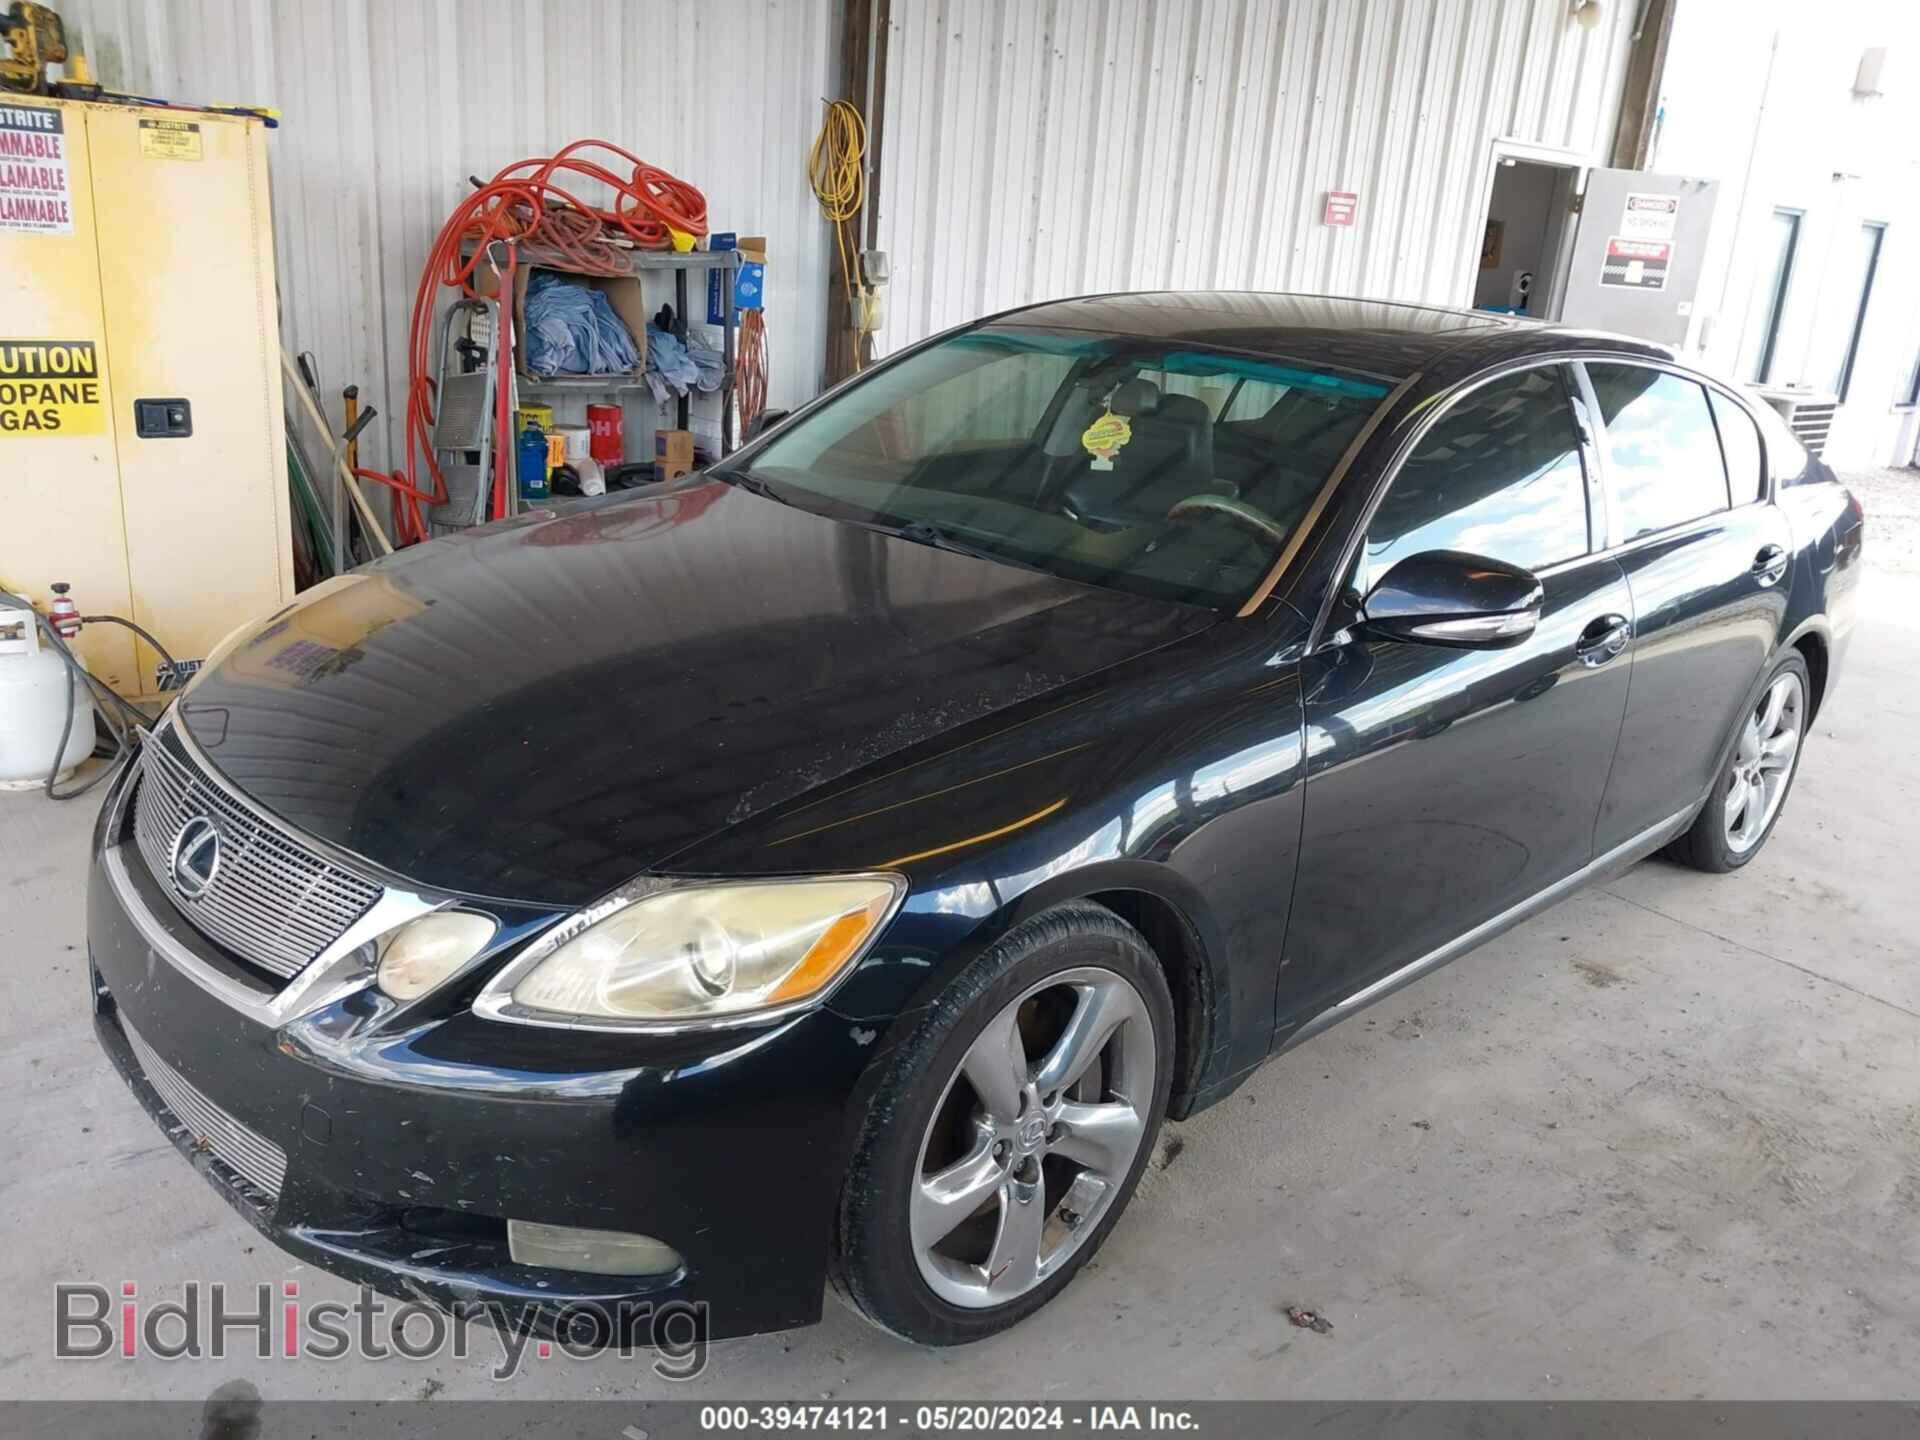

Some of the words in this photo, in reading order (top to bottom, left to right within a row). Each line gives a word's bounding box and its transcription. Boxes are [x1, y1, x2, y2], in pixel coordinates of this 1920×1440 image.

[0, 346, 94, 374] UTION
[0, 383, 99, 405] OPANE
[0, 409, 61, 430] GAS
